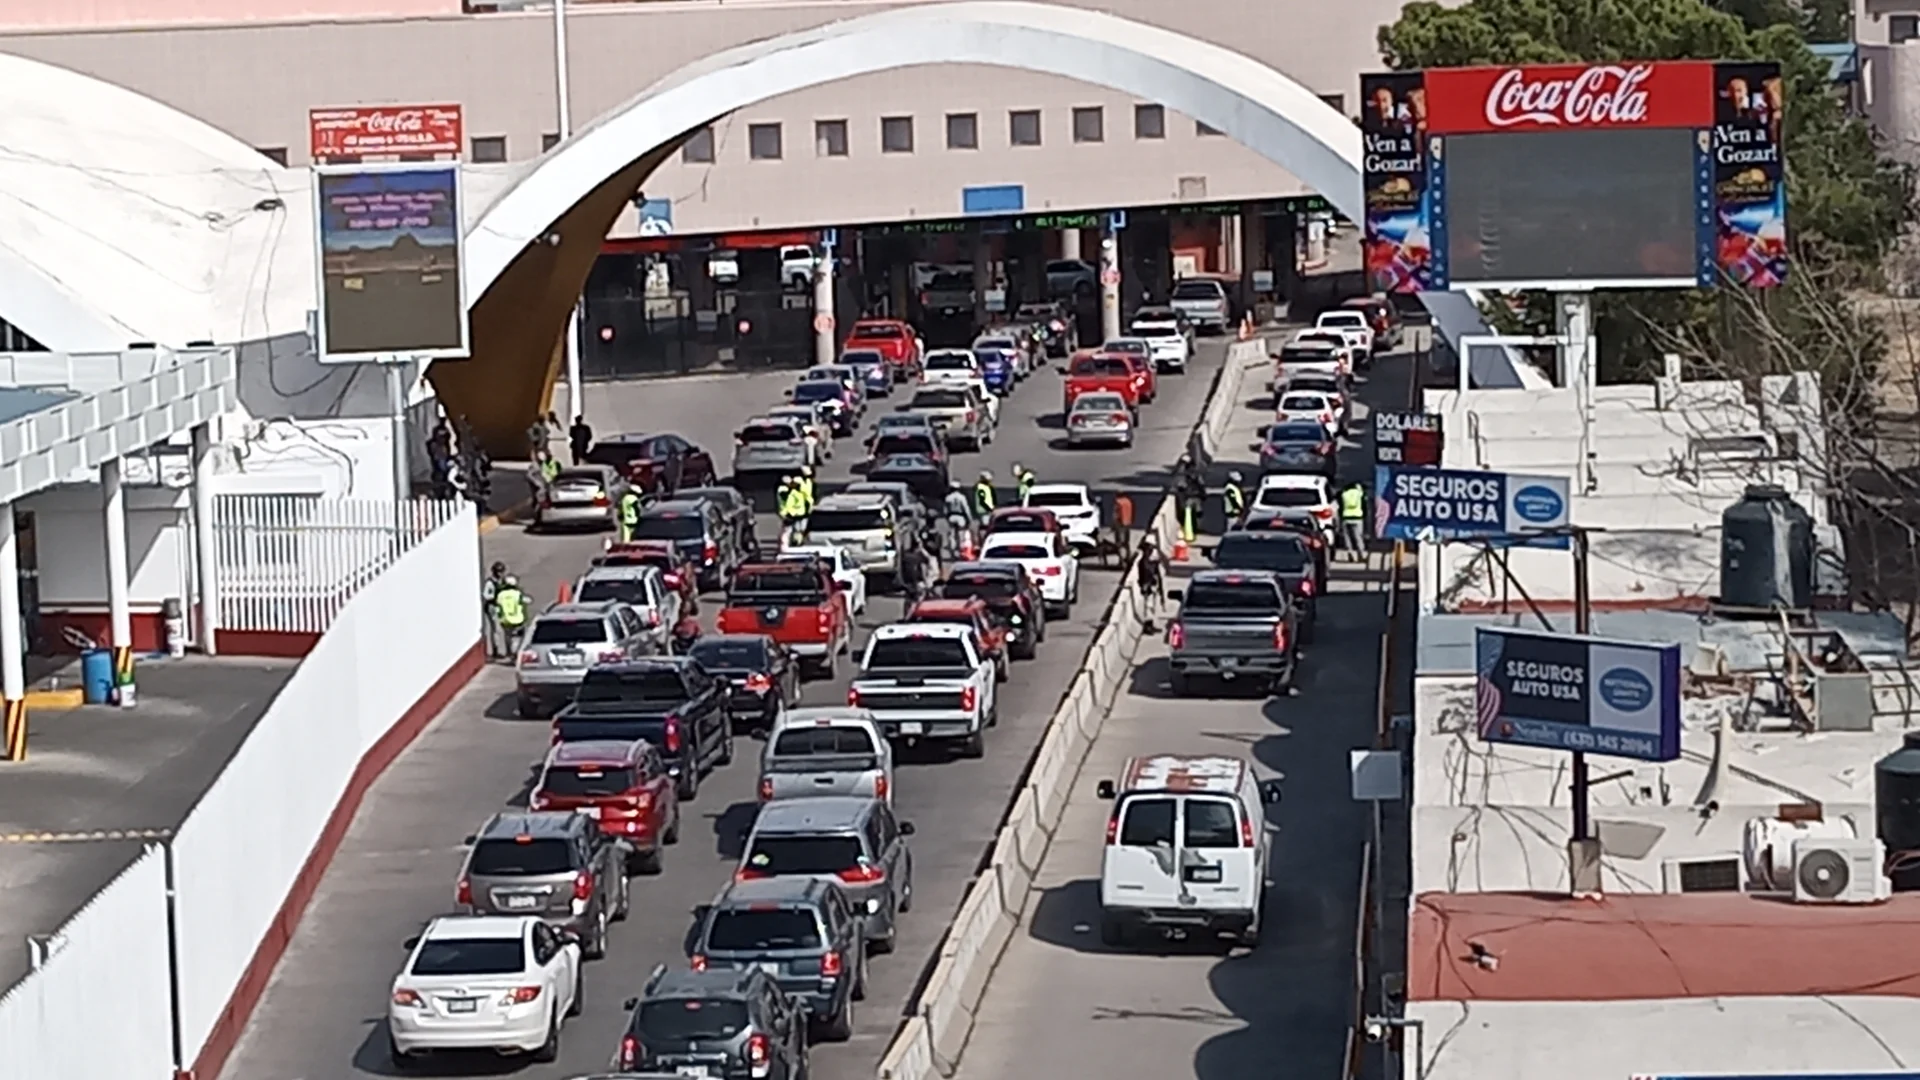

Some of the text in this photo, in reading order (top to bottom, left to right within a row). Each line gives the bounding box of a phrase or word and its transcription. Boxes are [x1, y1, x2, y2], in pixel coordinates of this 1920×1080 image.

[1400, 138, 1412, 152] a
[1756, 128, 1767, 142] a
[1365, 152, 1422, 173] Gozar!
[1717, 145, 1778, 164] Gozar!
[1395, 474, 1499, 501] SEGUROS
[1394, 498, 1498, 523] AUTO USA
[1506, 660, 1584, 684] SEGUROS
[1511, 680, 1580, 700] AUTO USA
